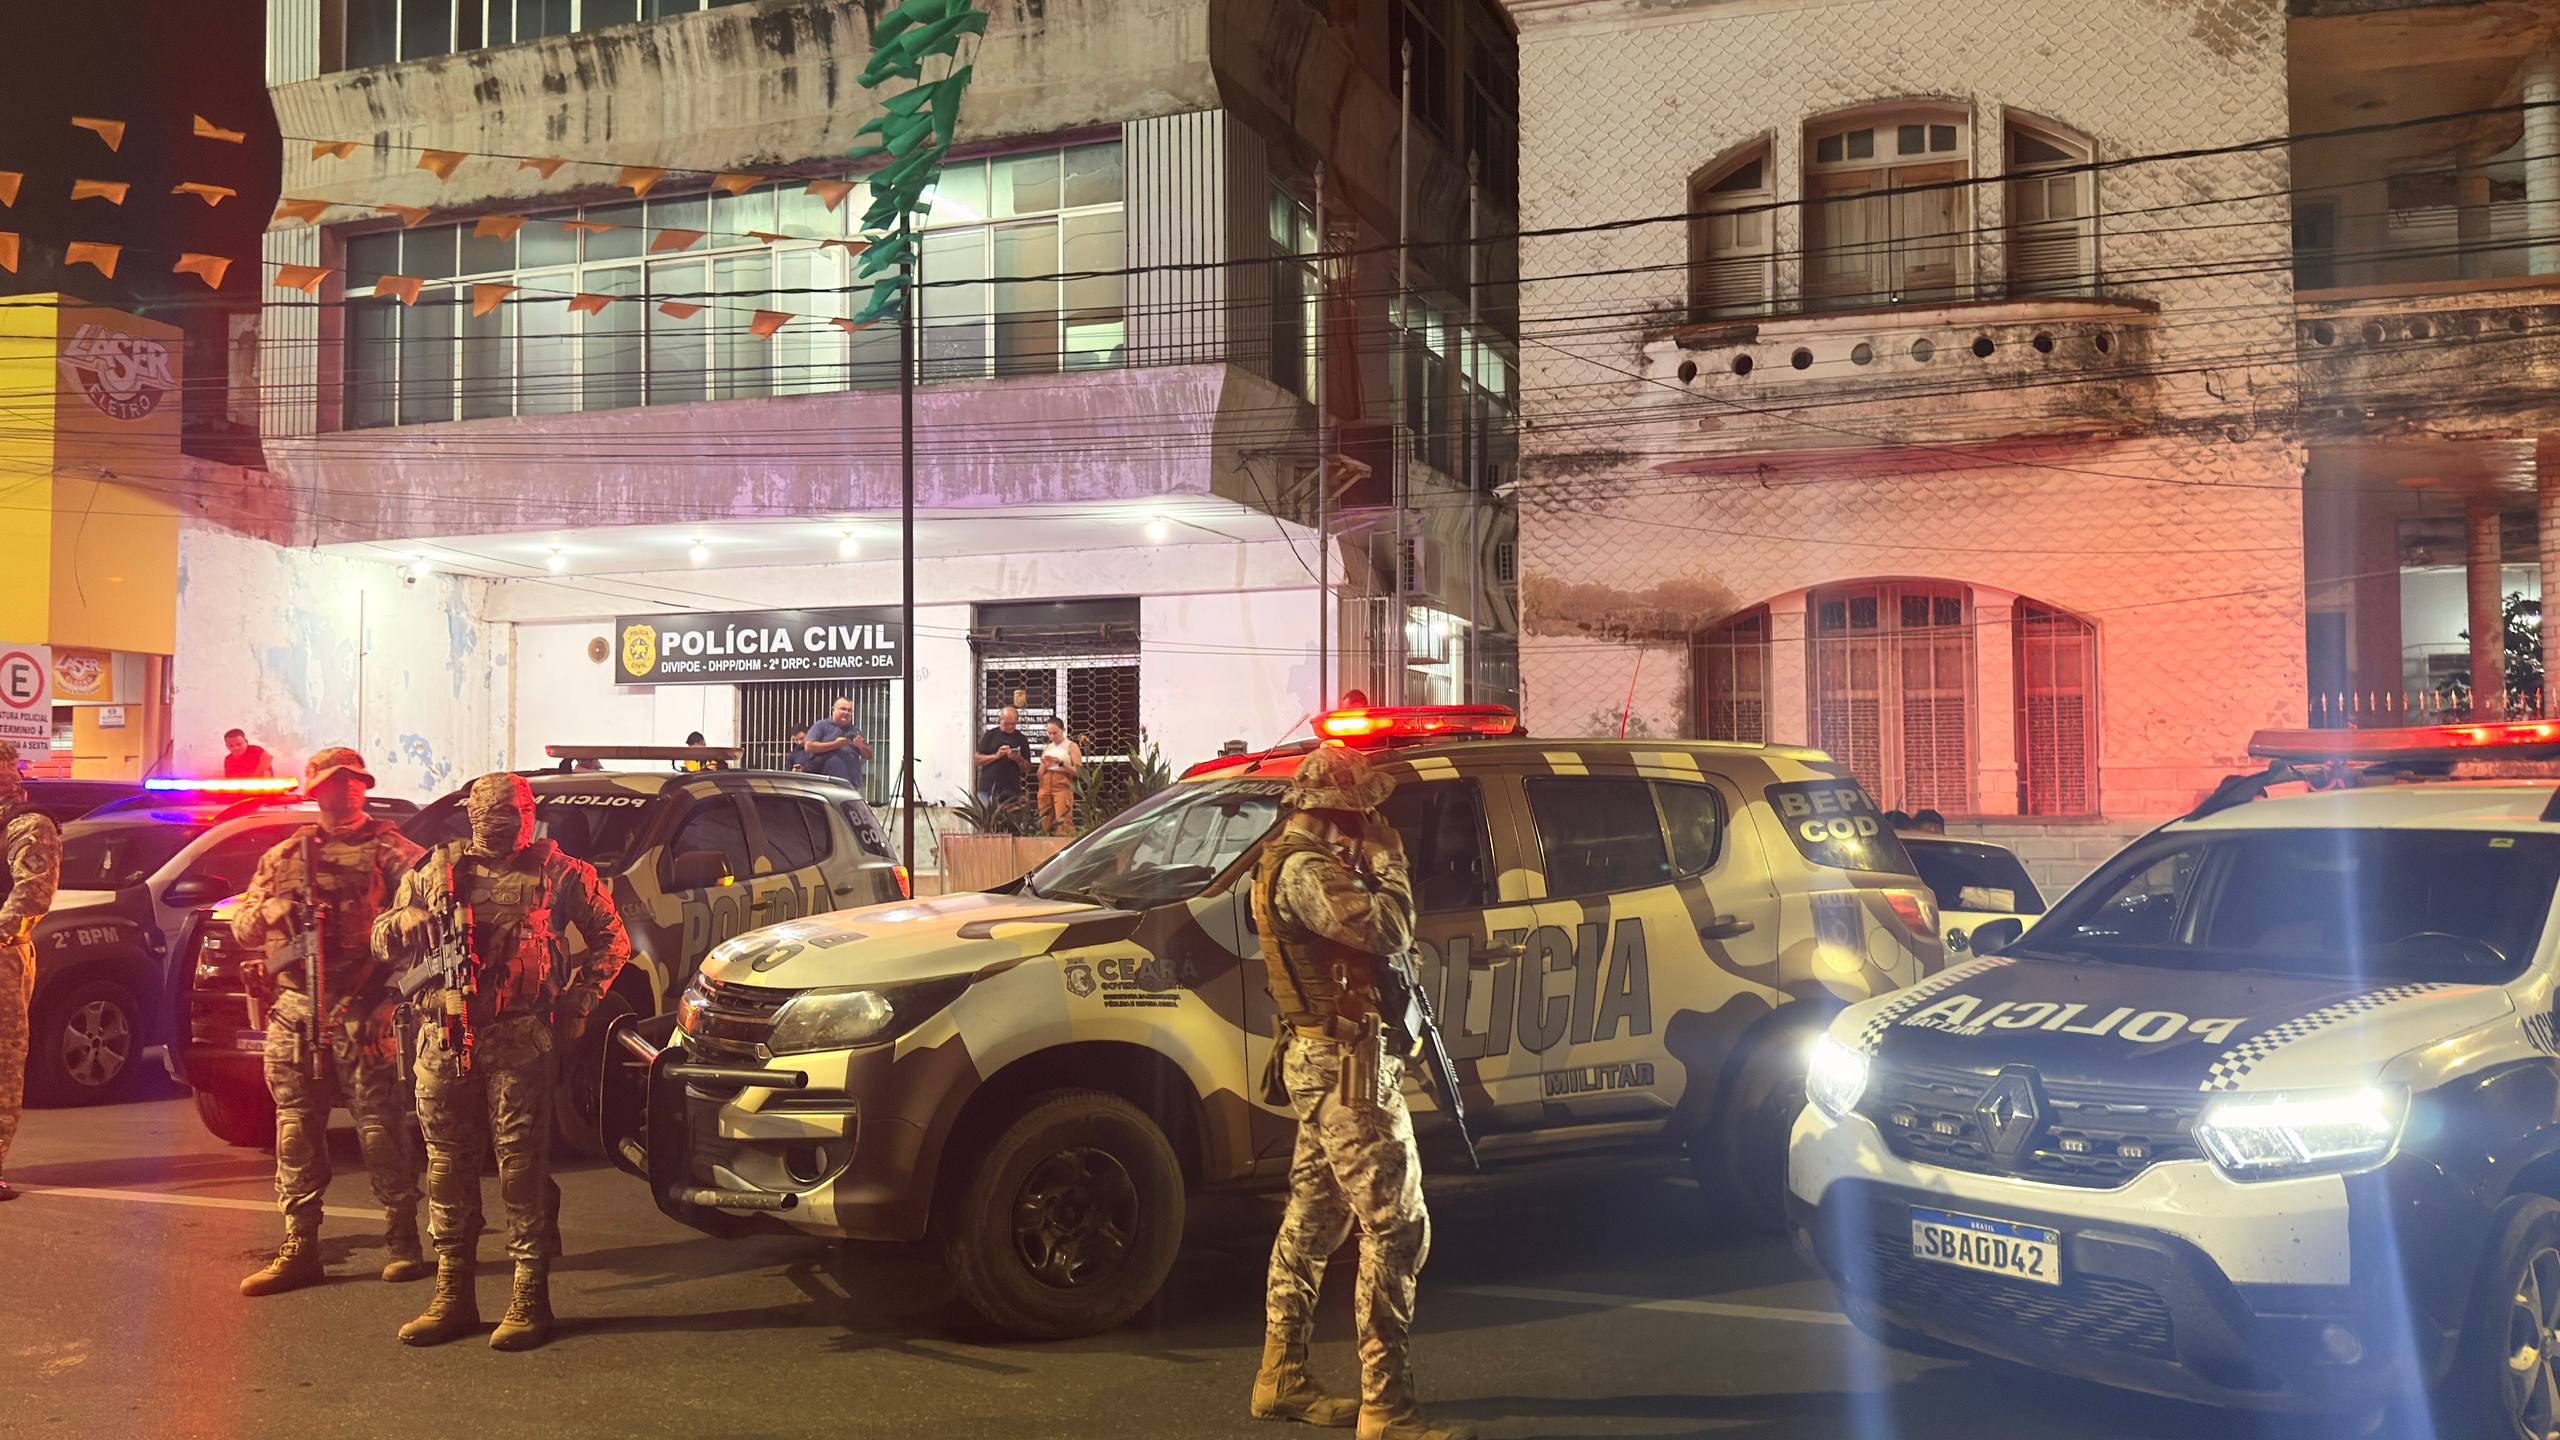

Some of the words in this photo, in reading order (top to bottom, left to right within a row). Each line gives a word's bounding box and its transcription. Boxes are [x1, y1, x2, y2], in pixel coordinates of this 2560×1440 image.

[64, 323, 176, 391] LASER
[88, 383, 151, 419] ELETRO
[661, 624, 794, 657] POLÍCIA
[803, 624, 895, 652] CIVIL
[661, 660, 701, 674] DIVIPOE
[708, 658, 761, 672] DHPP/DHM
[781, 657, 811, 670] DRPC
[818, 656, 863, 669] DENARC
[871, 655, 894, 668] DEA
[11, 664, 31, 698] E
[20, 712, 49, 723] POLICIAL
[28, 741, 49, 750] SEXTA
[1778, 788, 1876, 818] BEPI
[1799, 816, 1880, 843] COD
[77, 926, 120, 946] BPM
[1097, 952, 1200, 981] CEARÁ
[1545, 1062, 1655, 1097] MILITAR
[1970, 1220, 1995, 1233] BRASIL
